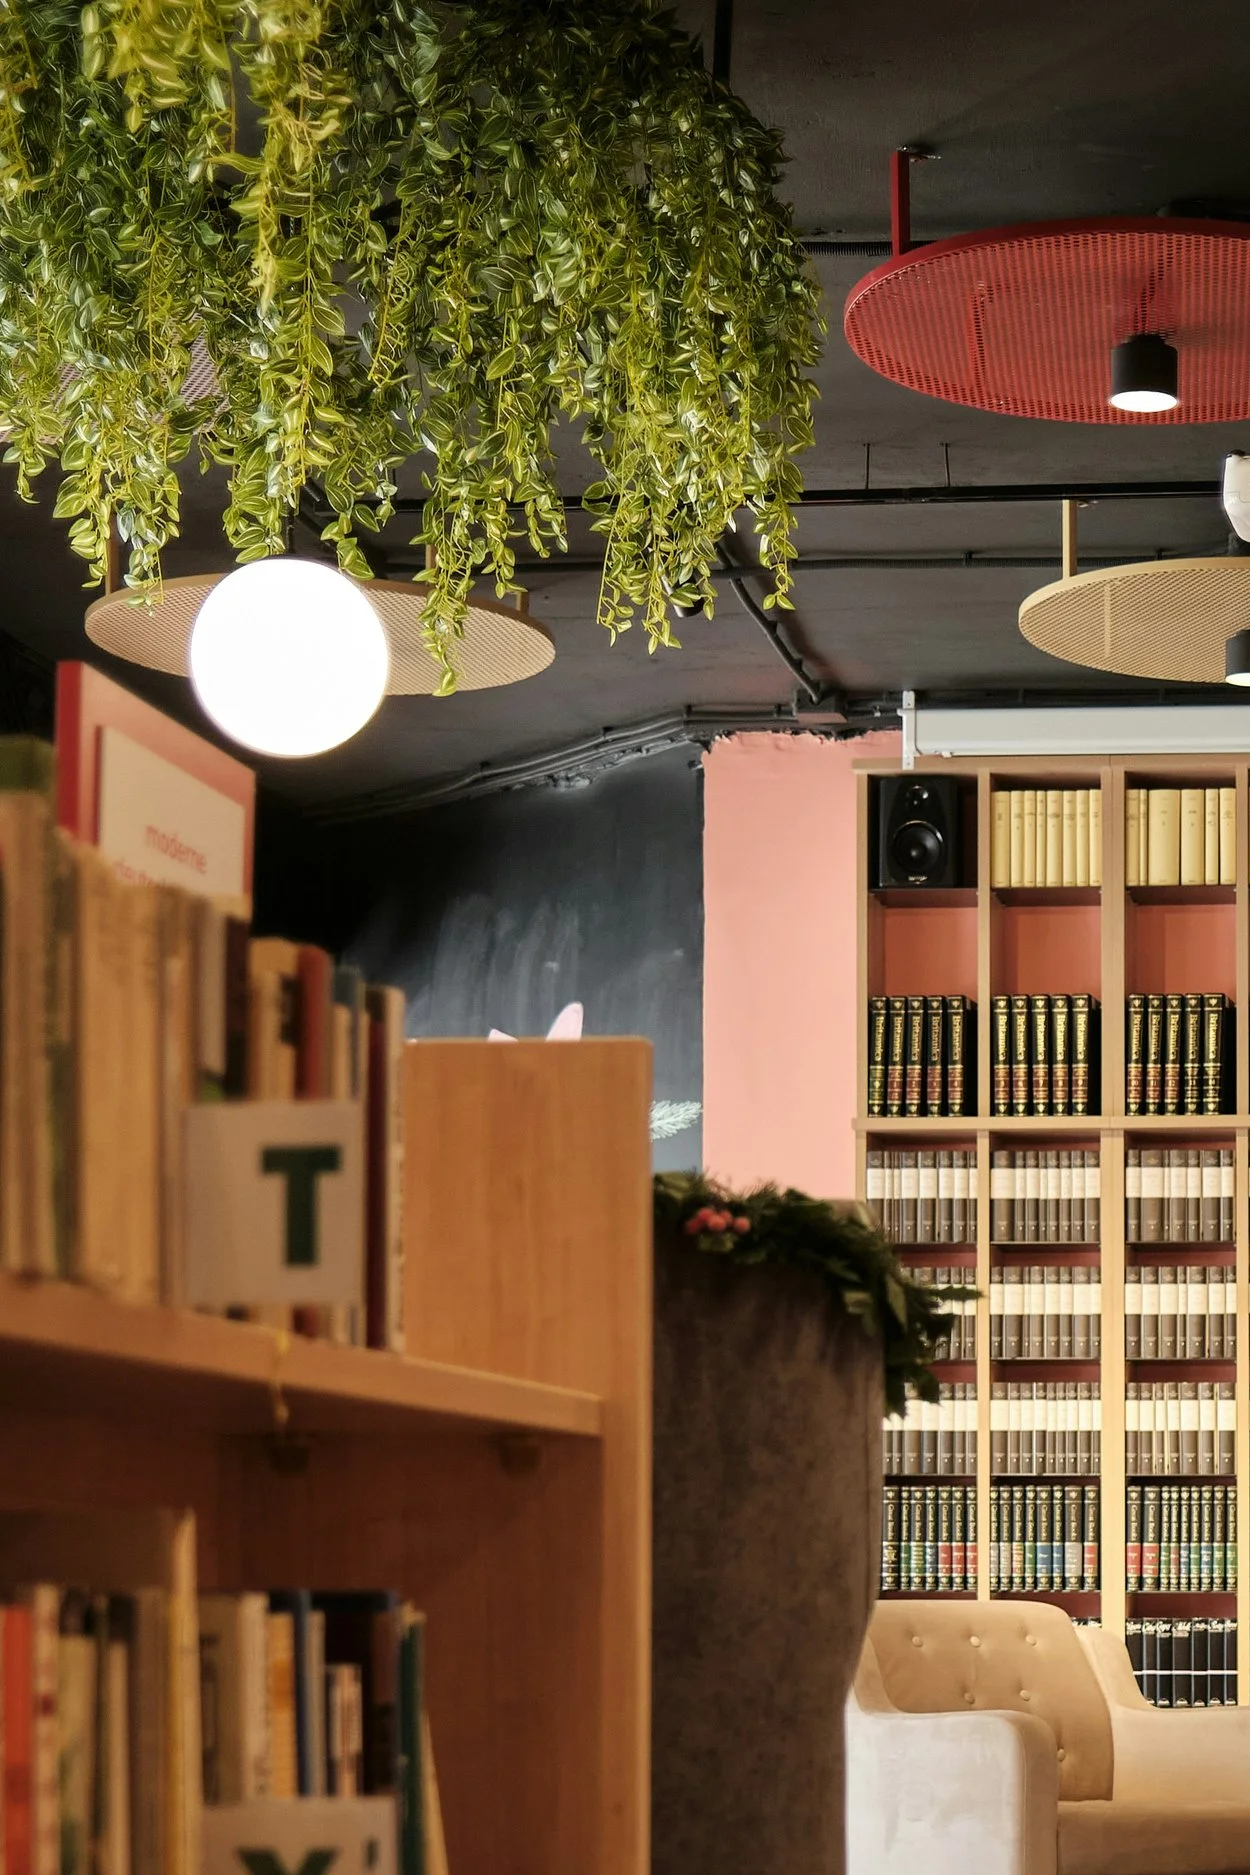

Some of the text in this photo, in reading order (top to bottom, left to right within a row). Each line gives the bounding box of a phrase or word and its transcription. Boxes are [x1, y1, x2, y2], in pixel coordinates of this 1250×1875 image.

[874, 1016, 884, 1061] Britannica
[893, 1016, 902, 1061] Britannica
[911, 1016, 921, 1061] Britannica
[931, 1016, 941, 1061] Britannica
[952, 1016, 962, 1061] Britannica
[998, 1014, 1007, 1060] Britannica
[1017, 1014, 1026, 1060] Britannica
[1036, 1014, 1046, 1060] Britannica
[1056, 1014, 1066, 1060] Britannica
[1077, 1014, 1086, 1060] Britannica
[1132, 1014, 1141, 1060] Britannica
[1151, 1014, 1160, 1060] Britannica
[1170, 1014, 1179, 1060] Britannica
[1189, 1014, 1198, 1060] Britannica
[1209, 1014, 1218, 1060] Britannica
[260, 1144, 343, 1267] T
